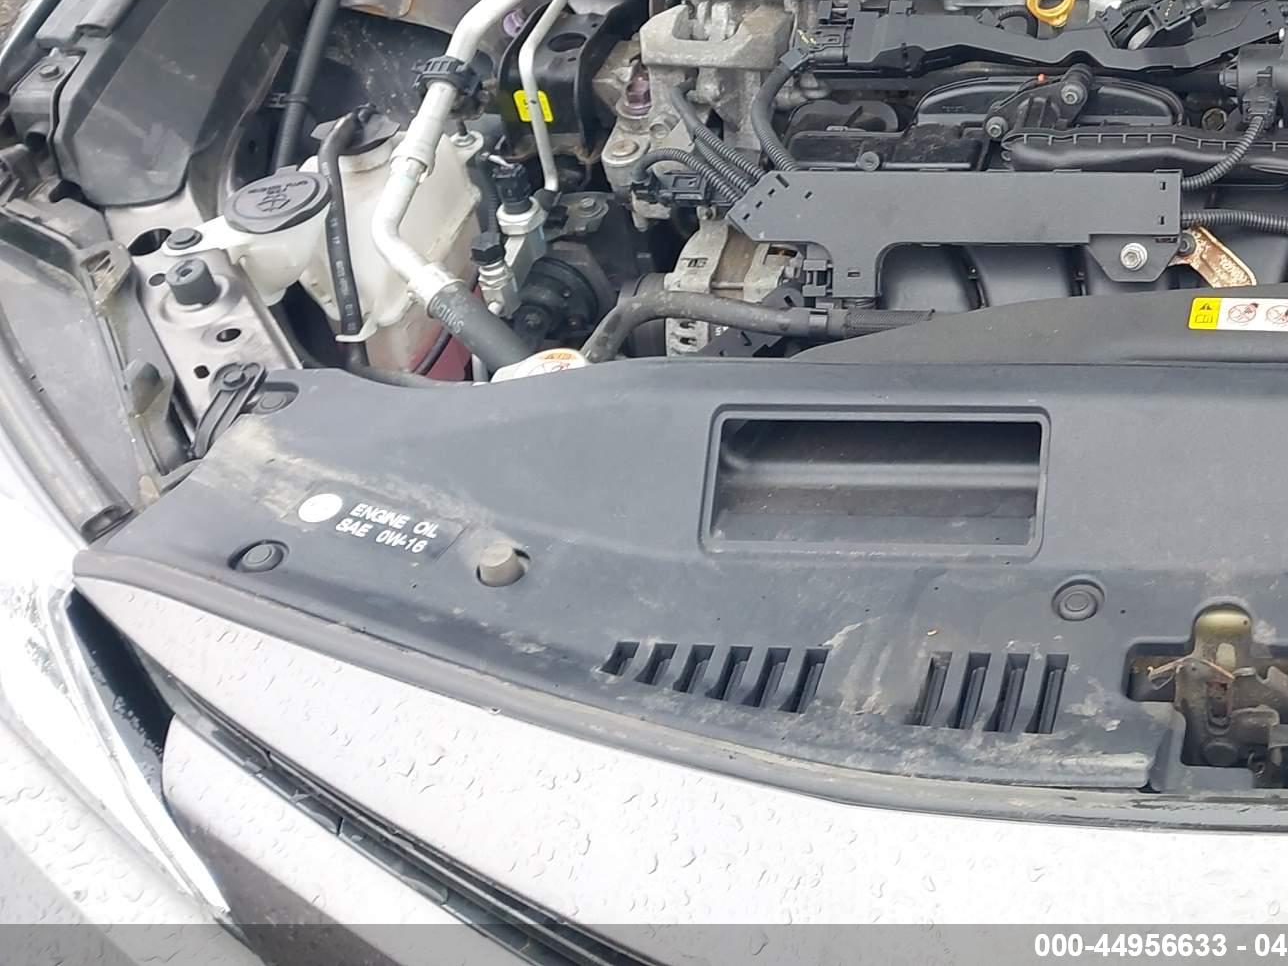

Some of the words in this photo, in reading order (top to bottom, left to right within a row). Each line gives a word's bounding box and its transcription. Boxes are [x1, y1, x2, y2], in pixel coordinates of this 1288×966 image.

[335, 518, 373, 537] SAE
[375, 530, 428, 553] 0W-16
[350, 503, 410, 529] ENGINE
[413, 521, 439, 539] OIL
